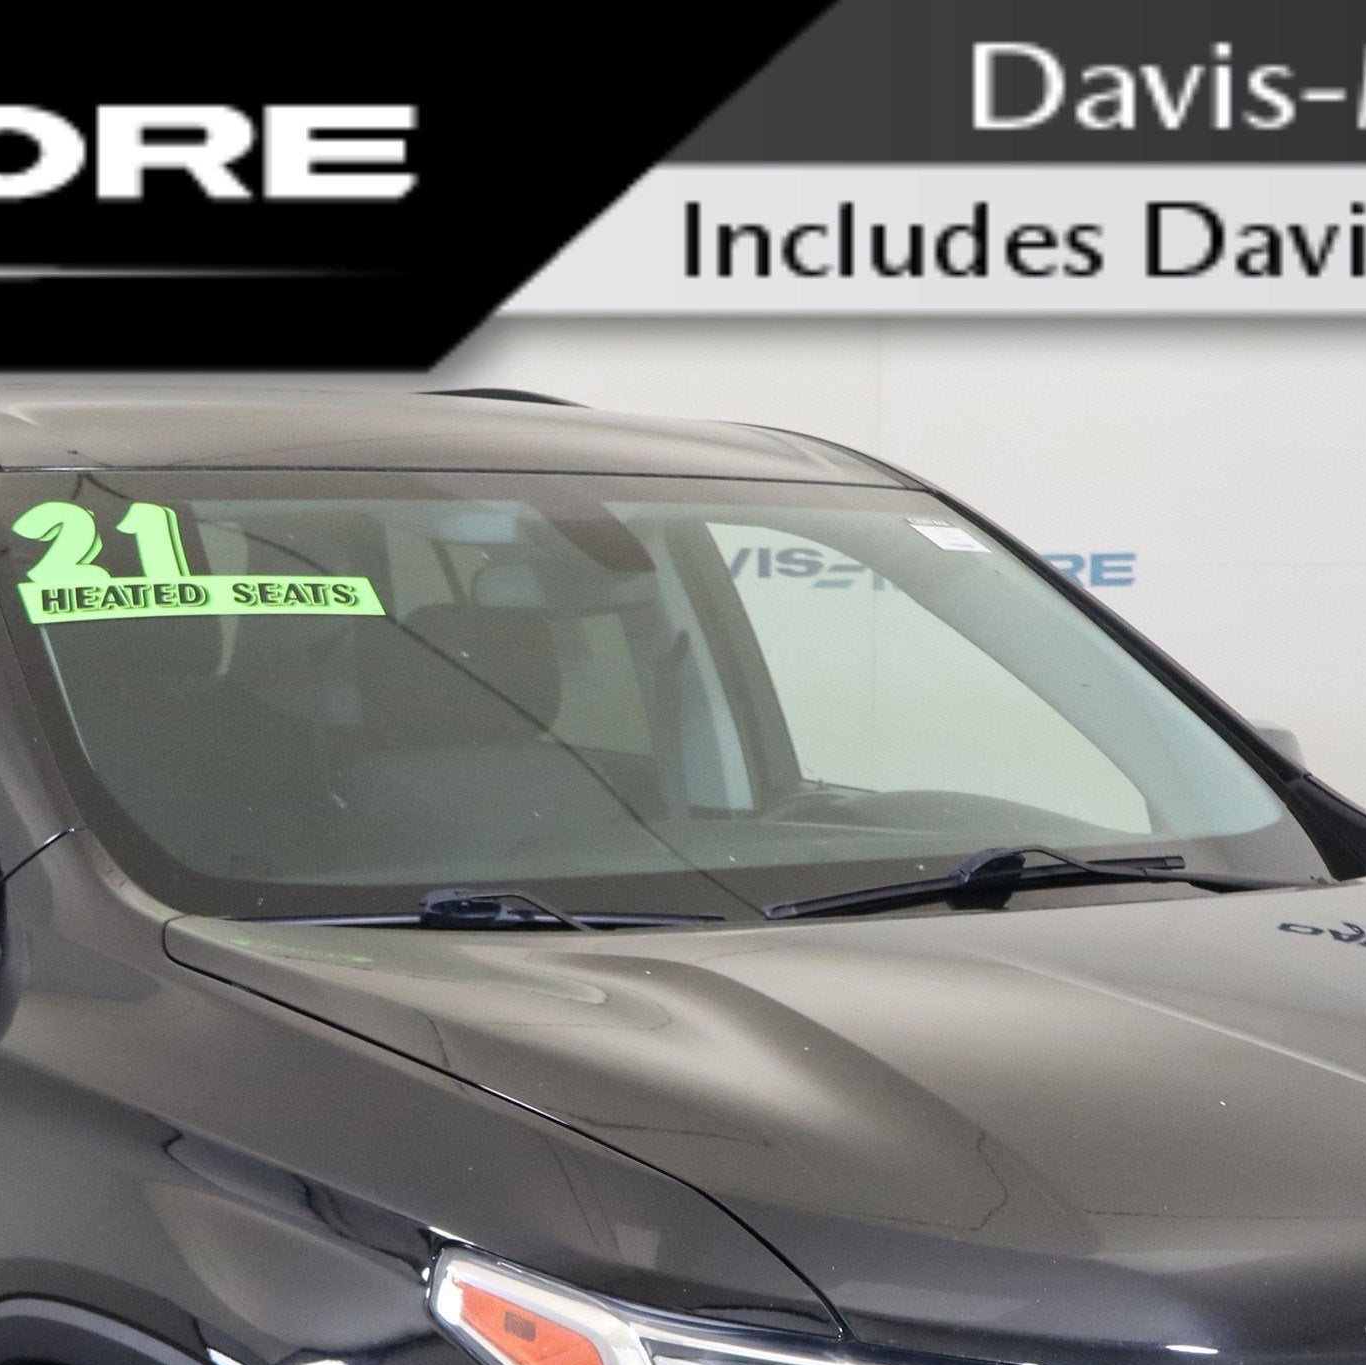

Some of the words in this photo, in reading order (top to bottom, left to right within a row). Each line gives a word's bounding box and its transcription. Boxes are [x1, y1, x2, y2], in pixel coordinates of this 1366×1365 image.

[11, 500, 191, 583] 21
[40, 582, 209, 614] HEATED
[232, 581, 360, 607] SEATS
